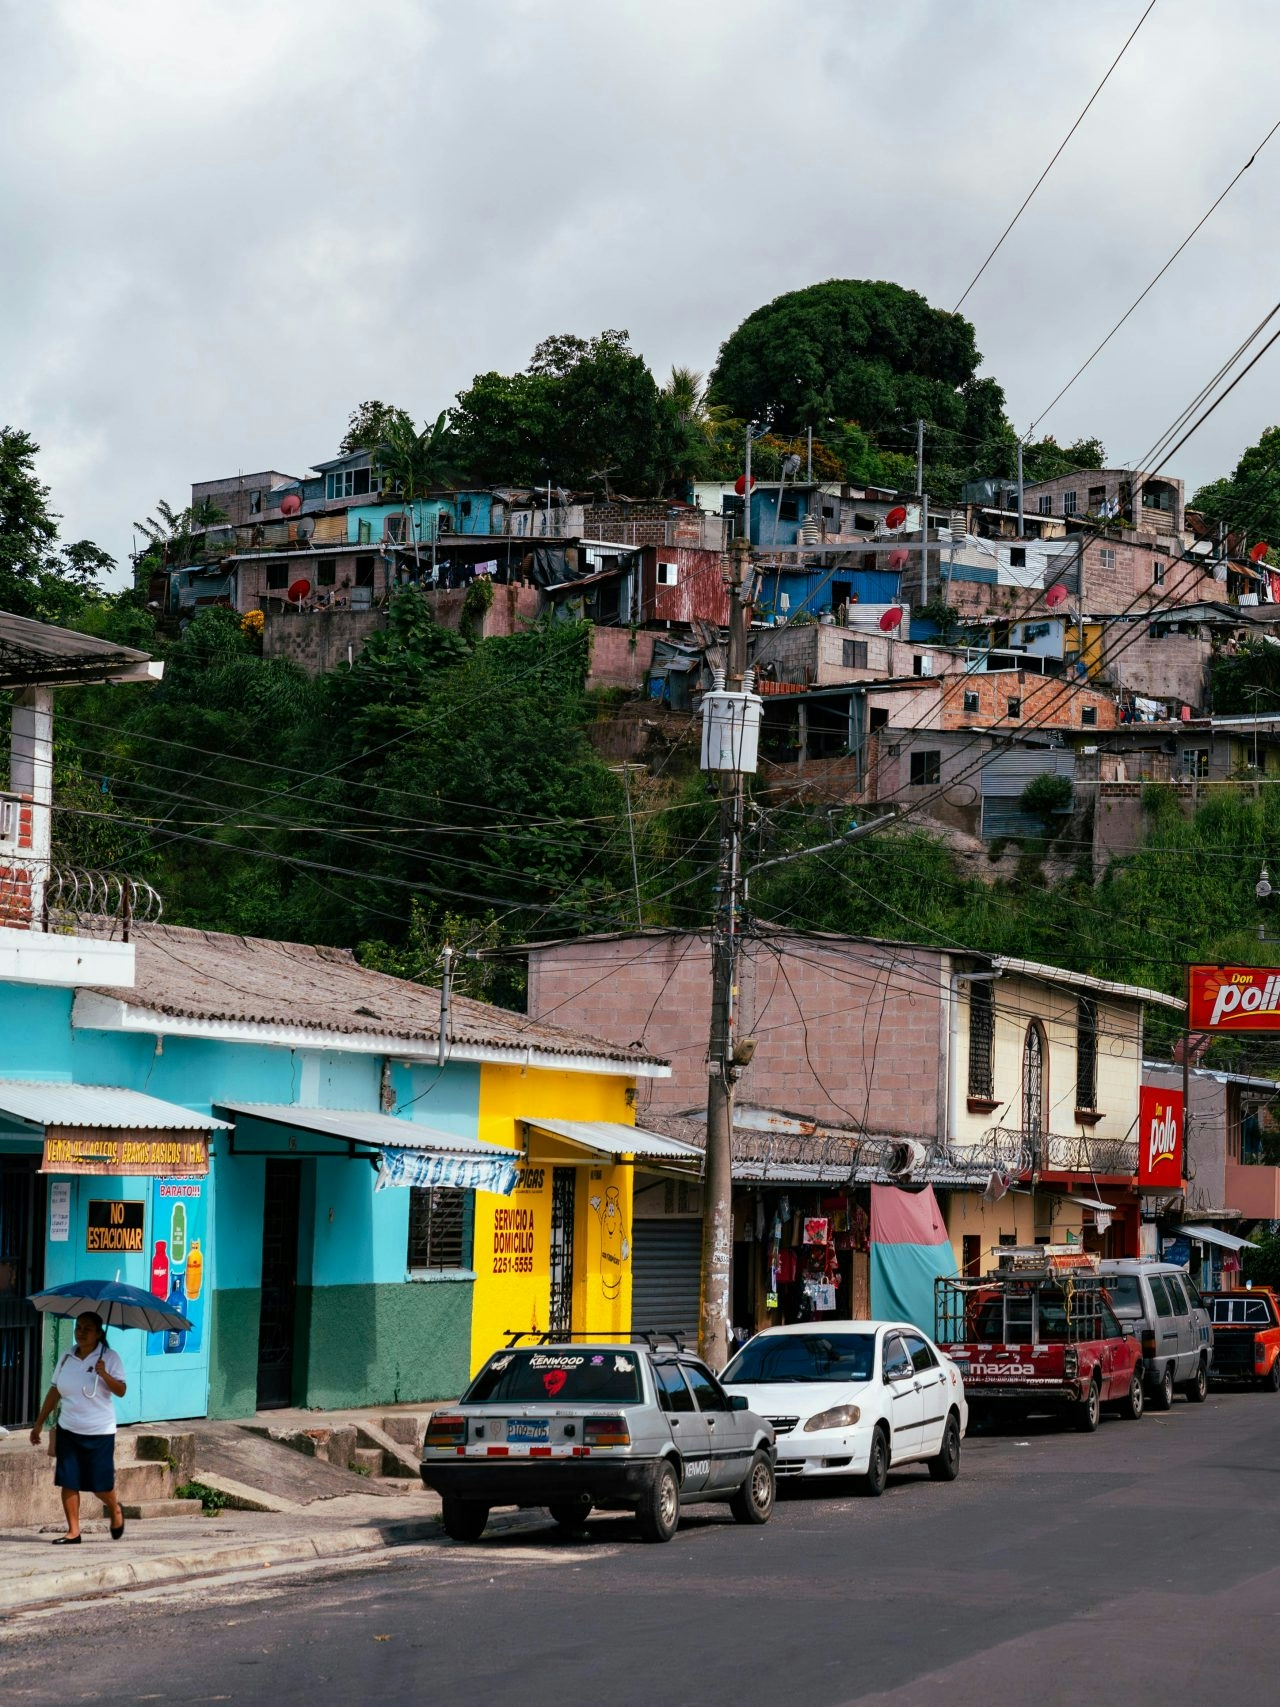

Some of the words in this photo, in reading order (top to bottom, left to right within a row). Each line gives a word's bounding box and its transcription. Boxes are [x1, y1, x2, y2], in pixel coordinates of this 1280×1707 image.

[1231, 973, 1254, 984] Don
[1148, 1105, 1177, 1173] pollo
[47, 1139, 71, 1162] VENTA
[151, 1142, 181, 1164] BASICOS
[183, 1143, 189, 1164] Y
[514, 1168, 545, 1189] PIGAS
[160, 1185, 200, 1197] BARATO!!!
[110, 1203, 125, 1224] NO
[494, 1209, 527, 1230] SERVICIO
[529, 1209, 534, 1230] A
[87, 1227, 142, 1249] ESTACIONAR
[493, 1232, 533, 1254] DOMICILIO
[493, 1257, 533, 1273] 2251-5555
[529, 1356, 584, 1366] KENWOOD
